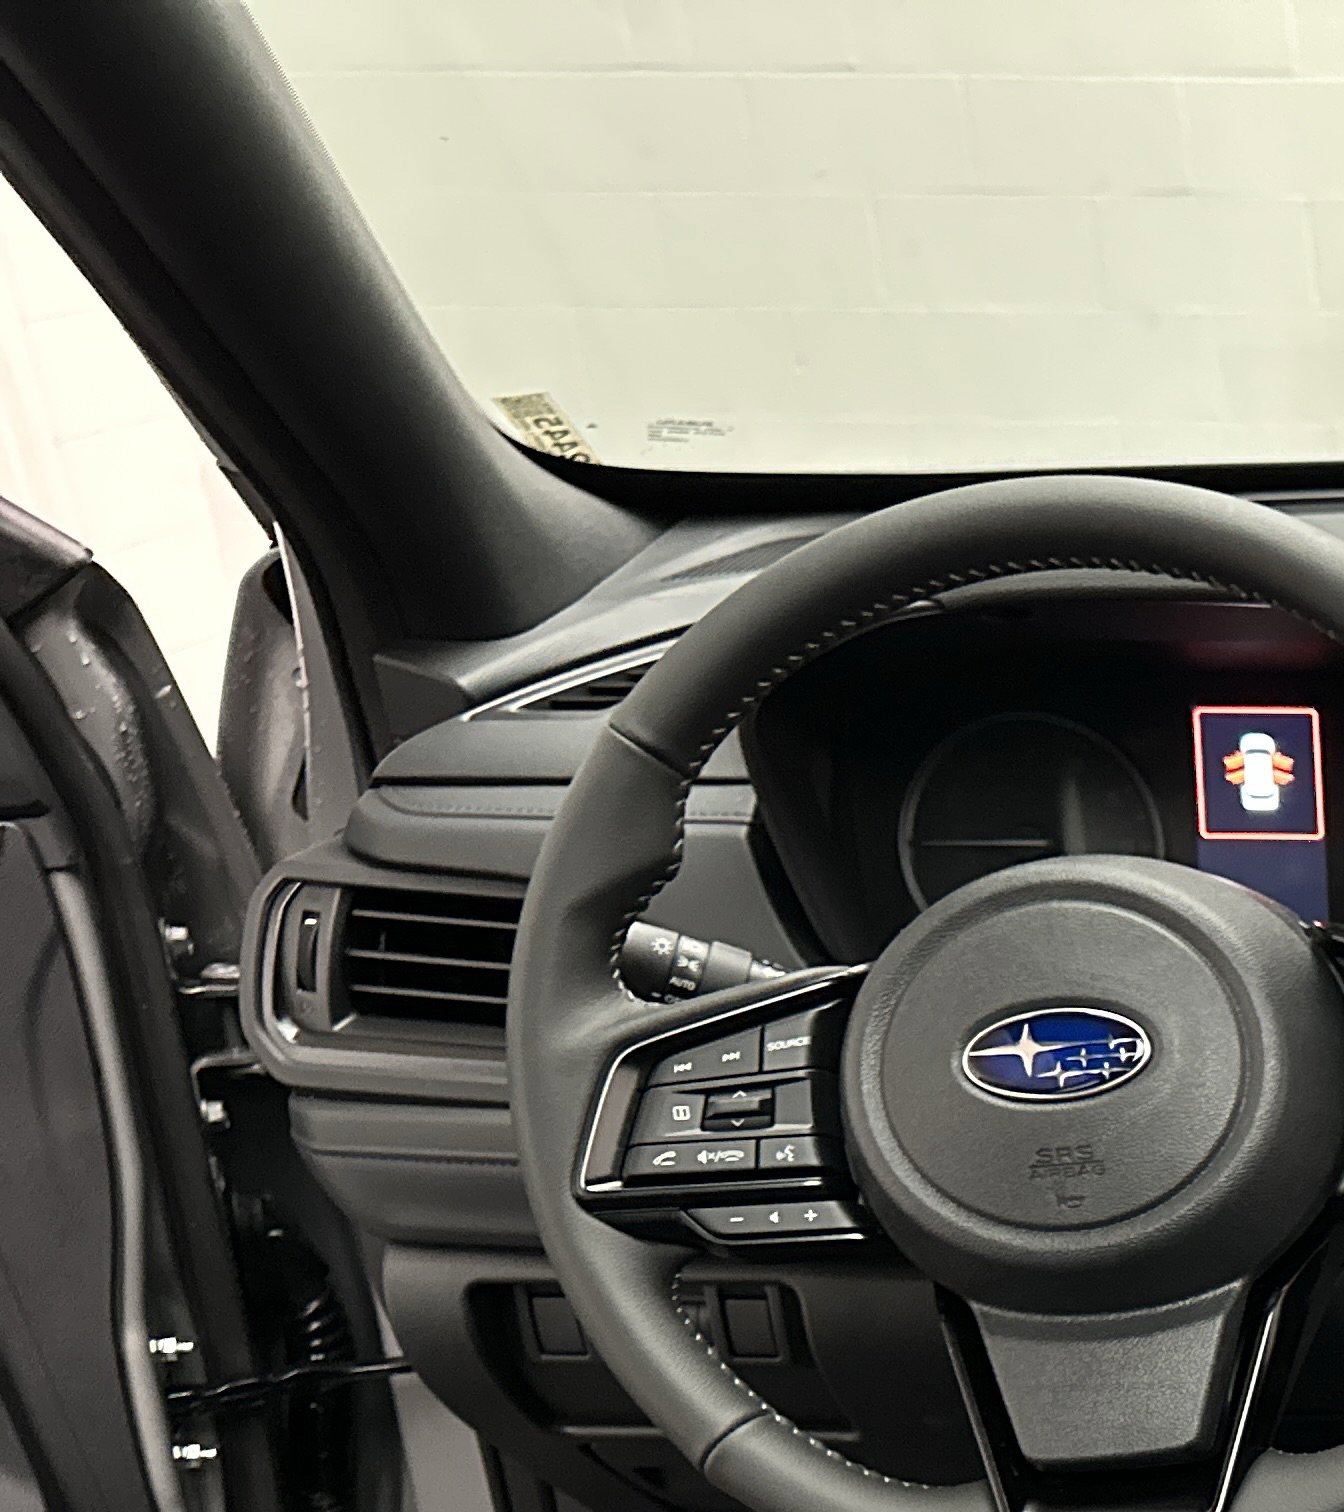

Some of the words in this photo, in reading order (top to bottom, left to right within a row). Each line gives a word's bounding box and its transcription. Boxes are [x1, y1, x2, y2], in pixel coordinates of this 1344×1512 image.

[669, 976, 696, 991] AUTO
[766, 1037, 812, 1051] SOURCE
[1035, 1144, 1094, 1163] SRS
